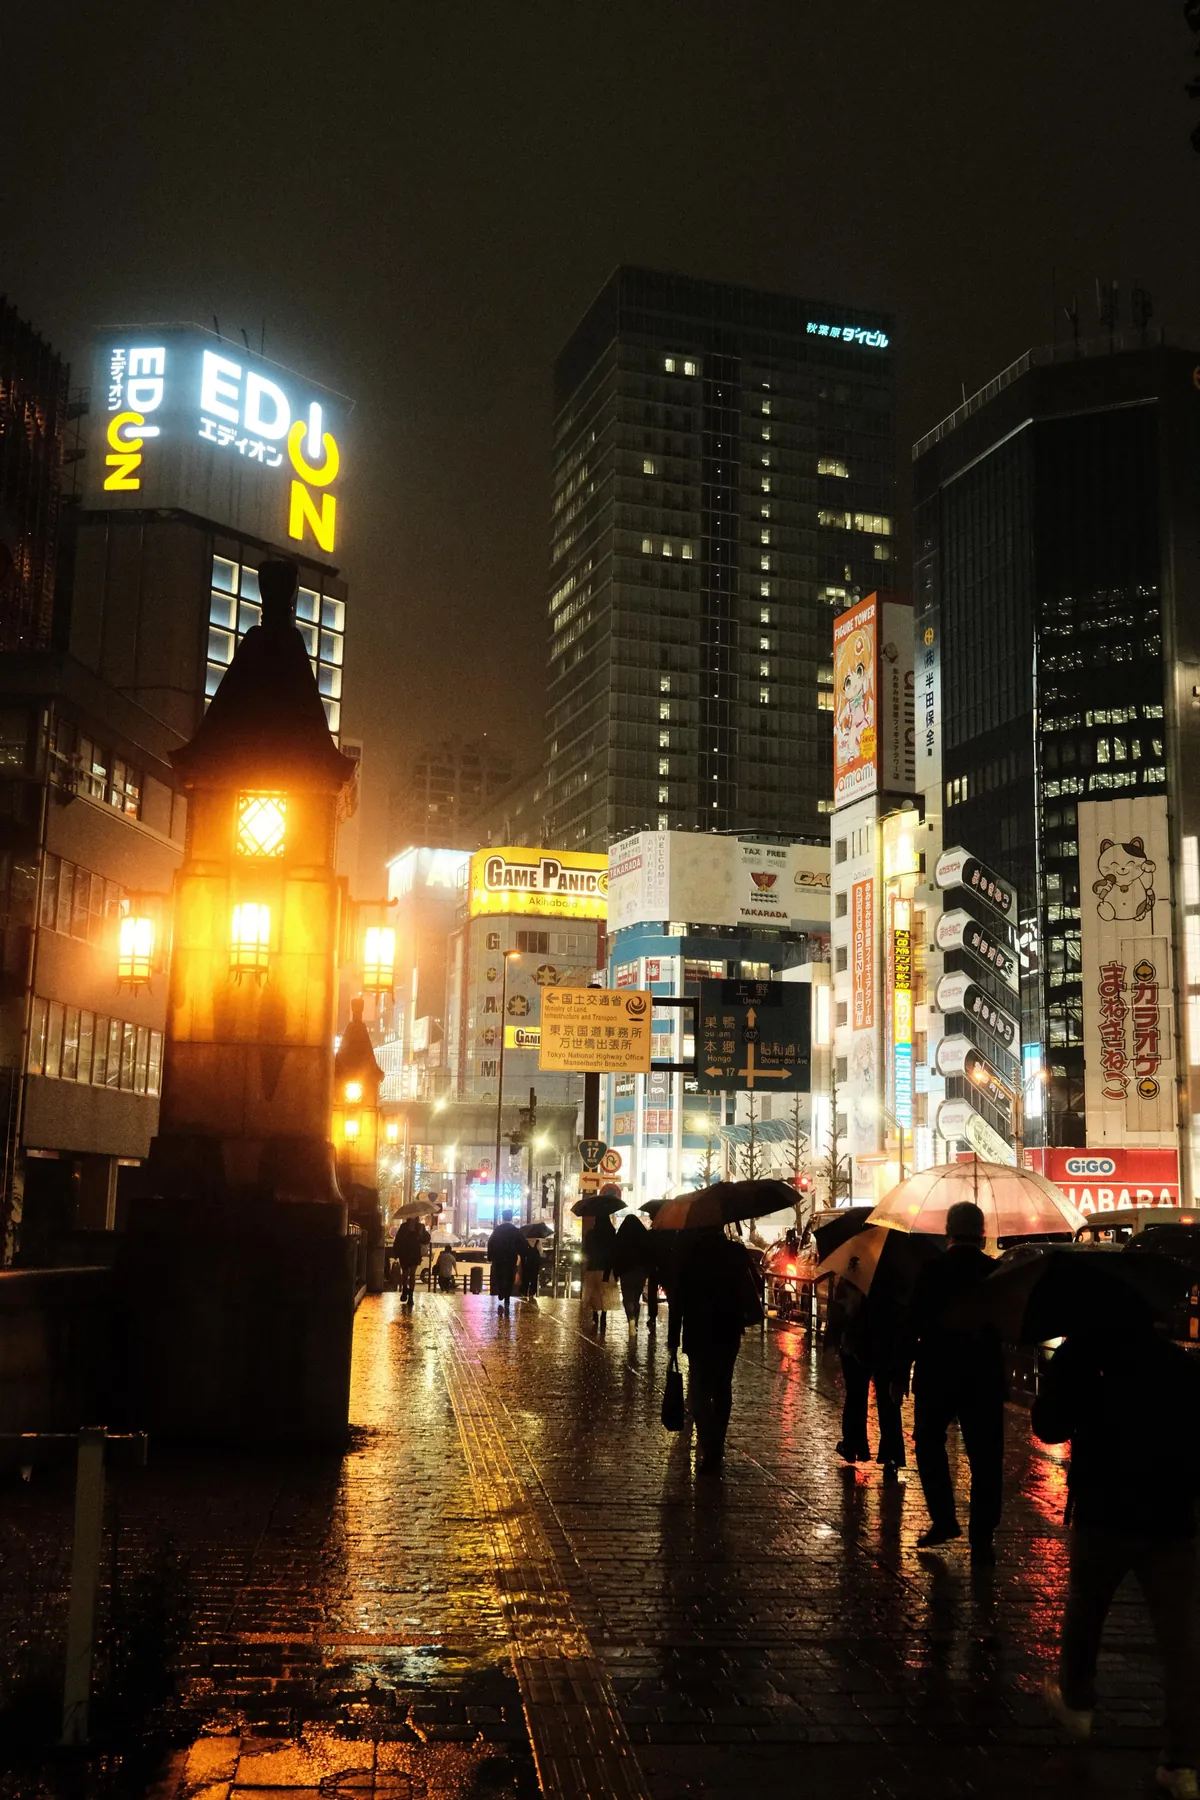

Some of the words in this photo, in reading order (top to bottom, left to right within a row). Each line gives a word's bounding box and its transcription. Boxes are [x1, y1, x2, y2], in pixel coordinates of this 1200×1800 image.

[806, 322, 889, 347] 秋葉原ダイビル
[108, 349, 126, 412] エディオン
[104, 346, 166, 491] EDION
[199, 416, 283, 467] エディオン
[199, 349, 341, 553] EDION
[834, 618, 853, 642] FIGURE
[853, 604, 875, 629] TOWER
[837, 762, 874, 792] amiami
[743, 847, 761, 856] TAX
[766, 849, 787, 858] FREE
[657, 834, 665, 886] WELCOME
[487, 858, 537, 889] GAME
[543, 861, 597, 892] PANIC
[609, 858, 641, 879] TAKARADA
[794, 871, 831, 888] GA
[528, 896, 578, 909] Akihabara
[740, 908, 788, 919] TAKARADA
[735, 982, 769, 997] 上野
[561, 993, 623, 1006] 国土交通省
[743, 997, 762, 1005] Ueno
[544, 1004, 565, 1013] Ministry
[543, 1012, 580, 1020] Infrastructure
[592, 1014, 618, 1022] Transport
[549, 1025, 643, 1039] 東京国道事務所
[1098, 961, 1131, 1100] まねきねこ
[1133, 982, 1160, 1080] カラオケ
[559, 1037, 632, 1051] 万世橋出張所
[704, 1040, 736, 1054] 本郷
[547, 1051, 566, 1059] Tokyo
[596, 1053, 622, 1061] Highway
[625, 1053, 645, 1061] Office
[707, 1055, 732, 1064] Hongo
[725, 1067, 736, 1077] 17
[587, 1147, 600, 1159] 17
[1067, 1160, 1113, 1173] GiGO
